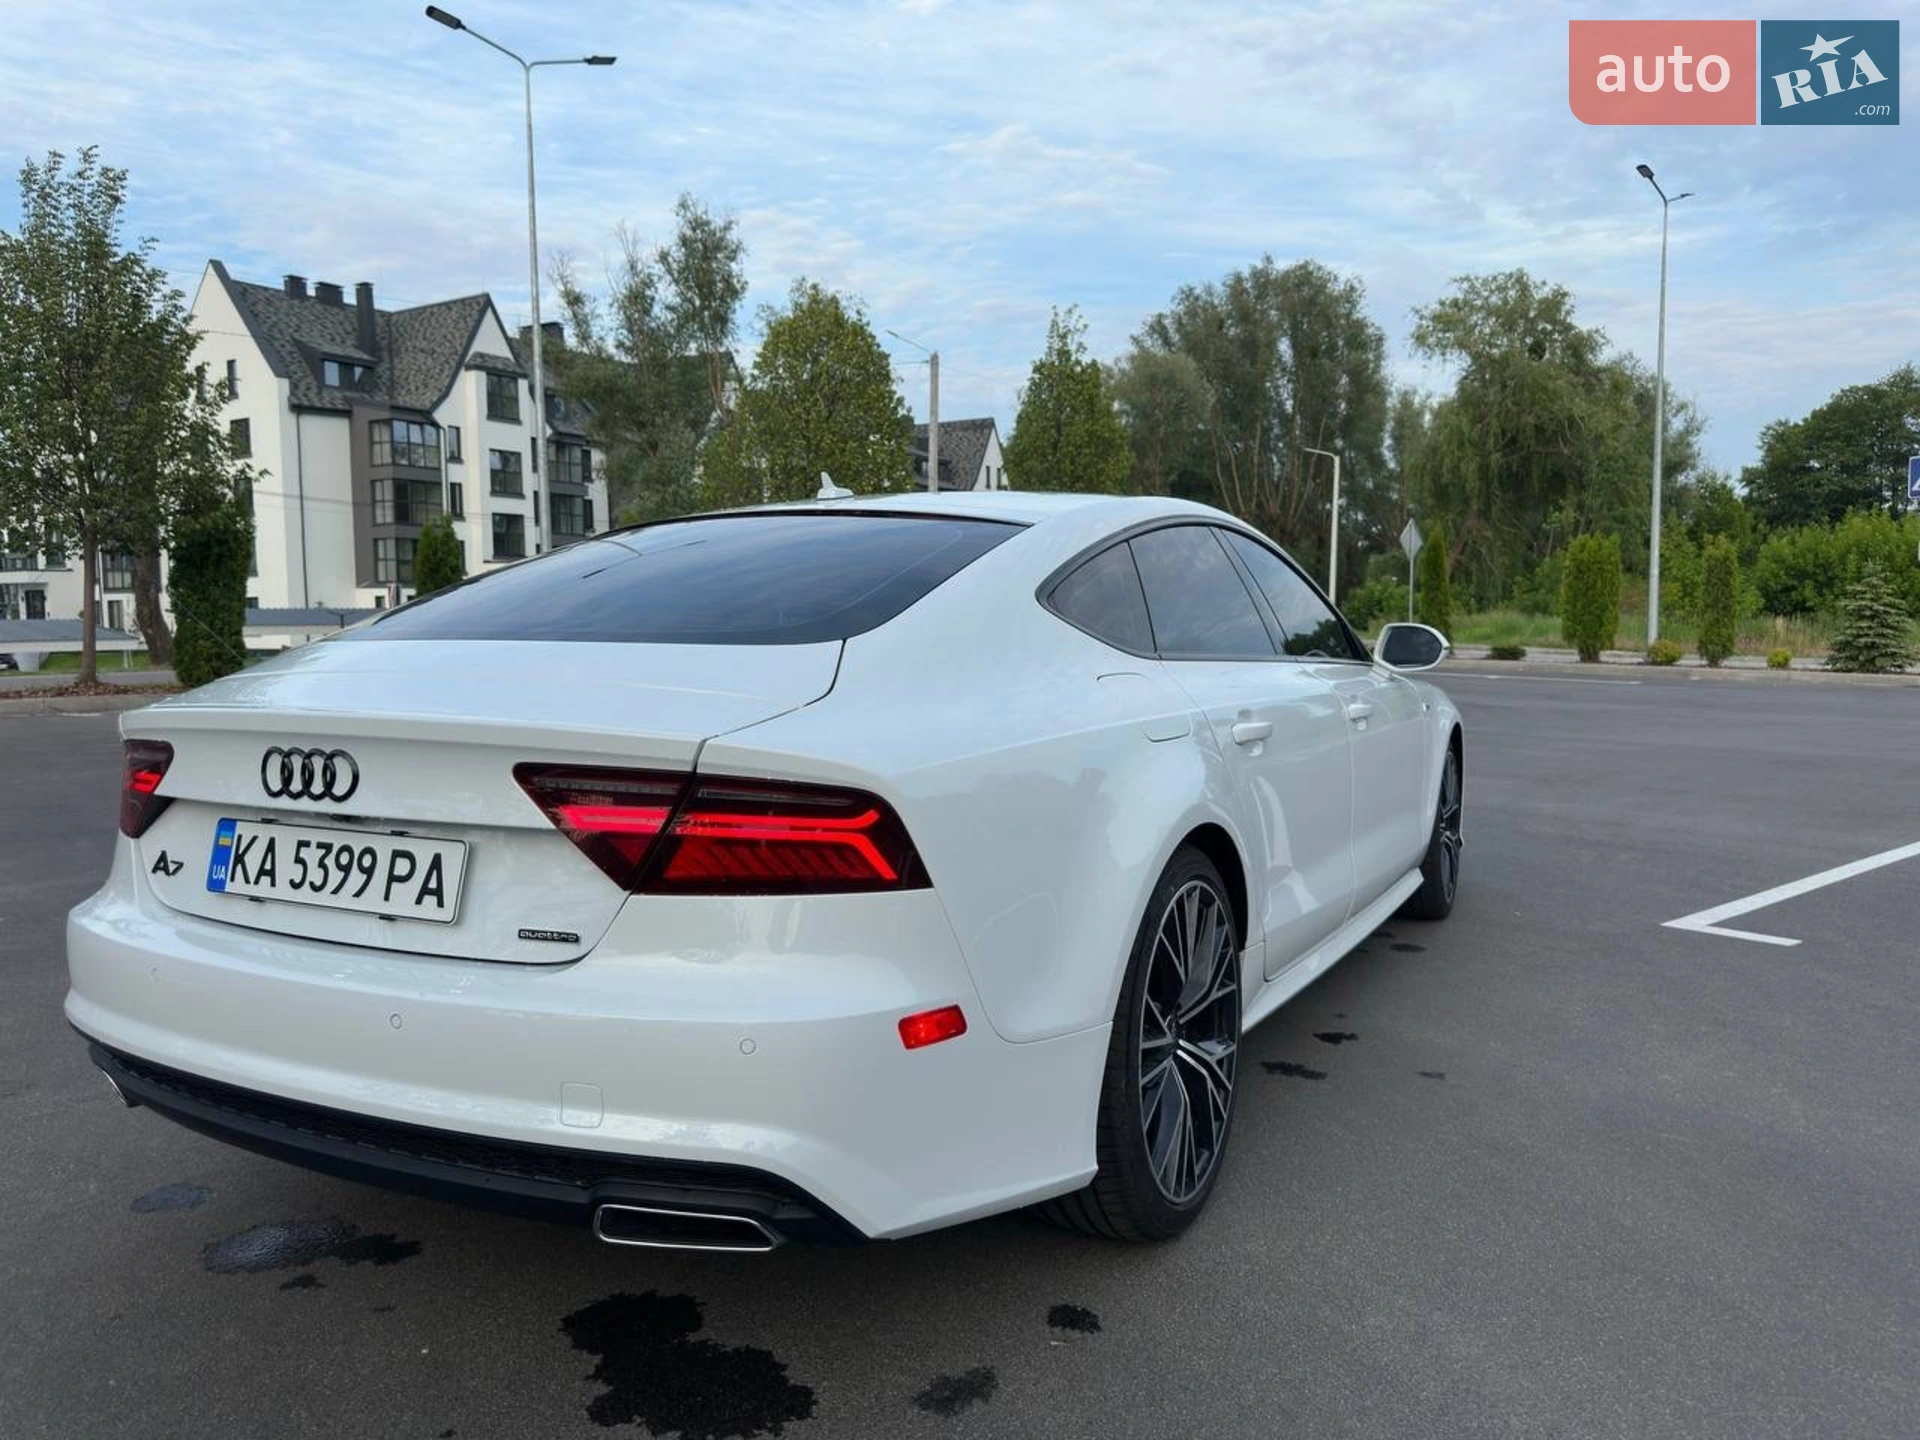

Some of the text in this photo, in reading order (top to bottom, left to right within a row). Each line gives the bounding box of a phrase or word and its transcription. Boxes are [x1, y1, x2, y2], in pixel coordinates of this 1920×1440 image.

[151, 850, 184, 876] A7
[212, 864, 226, 880] UA
[230, 833, 445, 908] KA 5399 PA
[519, 930, 578, 942] quattro
